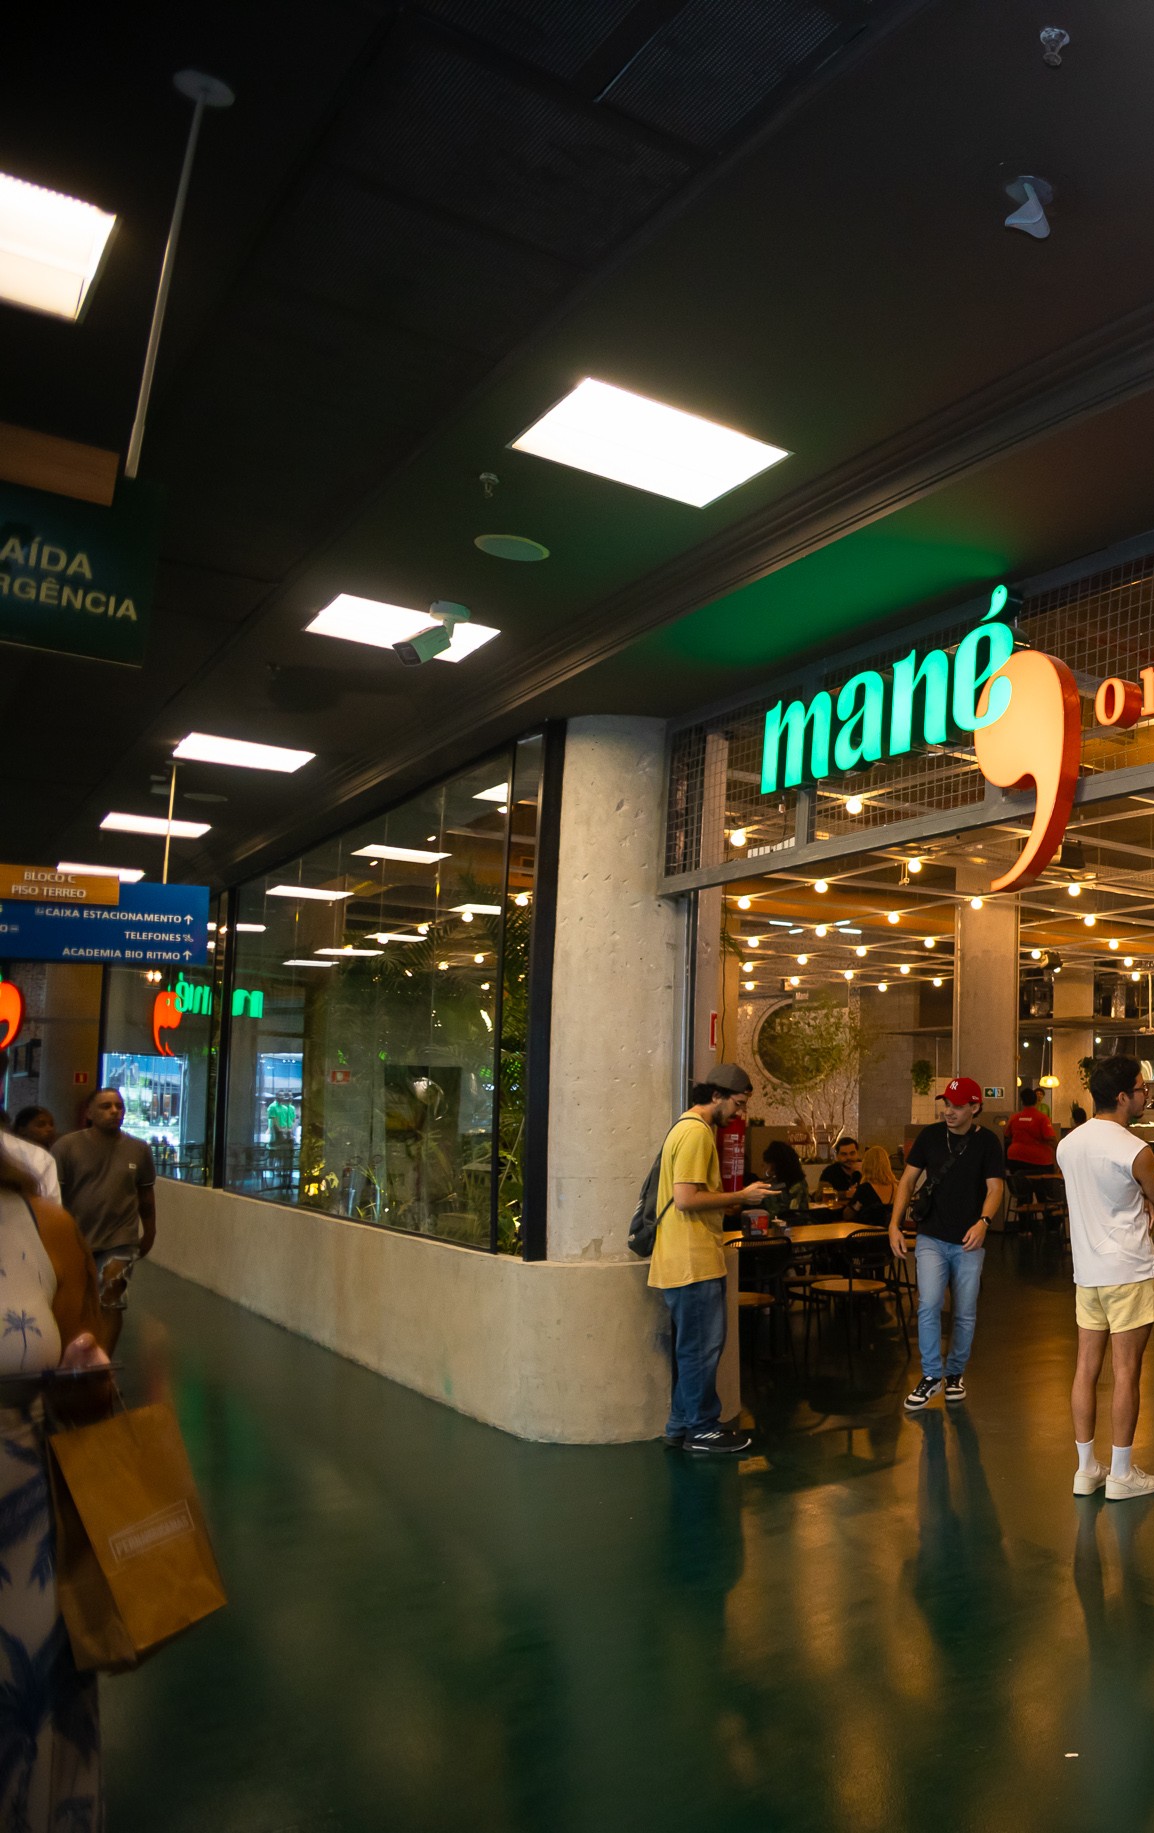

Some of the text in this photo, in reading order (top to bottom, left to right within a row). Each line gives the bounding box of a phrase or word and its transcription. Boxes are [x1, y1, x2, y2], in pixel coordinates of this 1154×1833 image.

[1094, 675, 1130, 729] o
[24, 871, 65, 883] BLOCO
[11, 885, 39, 896] PISO
[45, 908, 182, 923] CAIXA ESTACIONAMENTO
[124, 931, 181, 942] TELEFONES
[62, 947, 181, 961] ACADEMIA BIO RITMO
